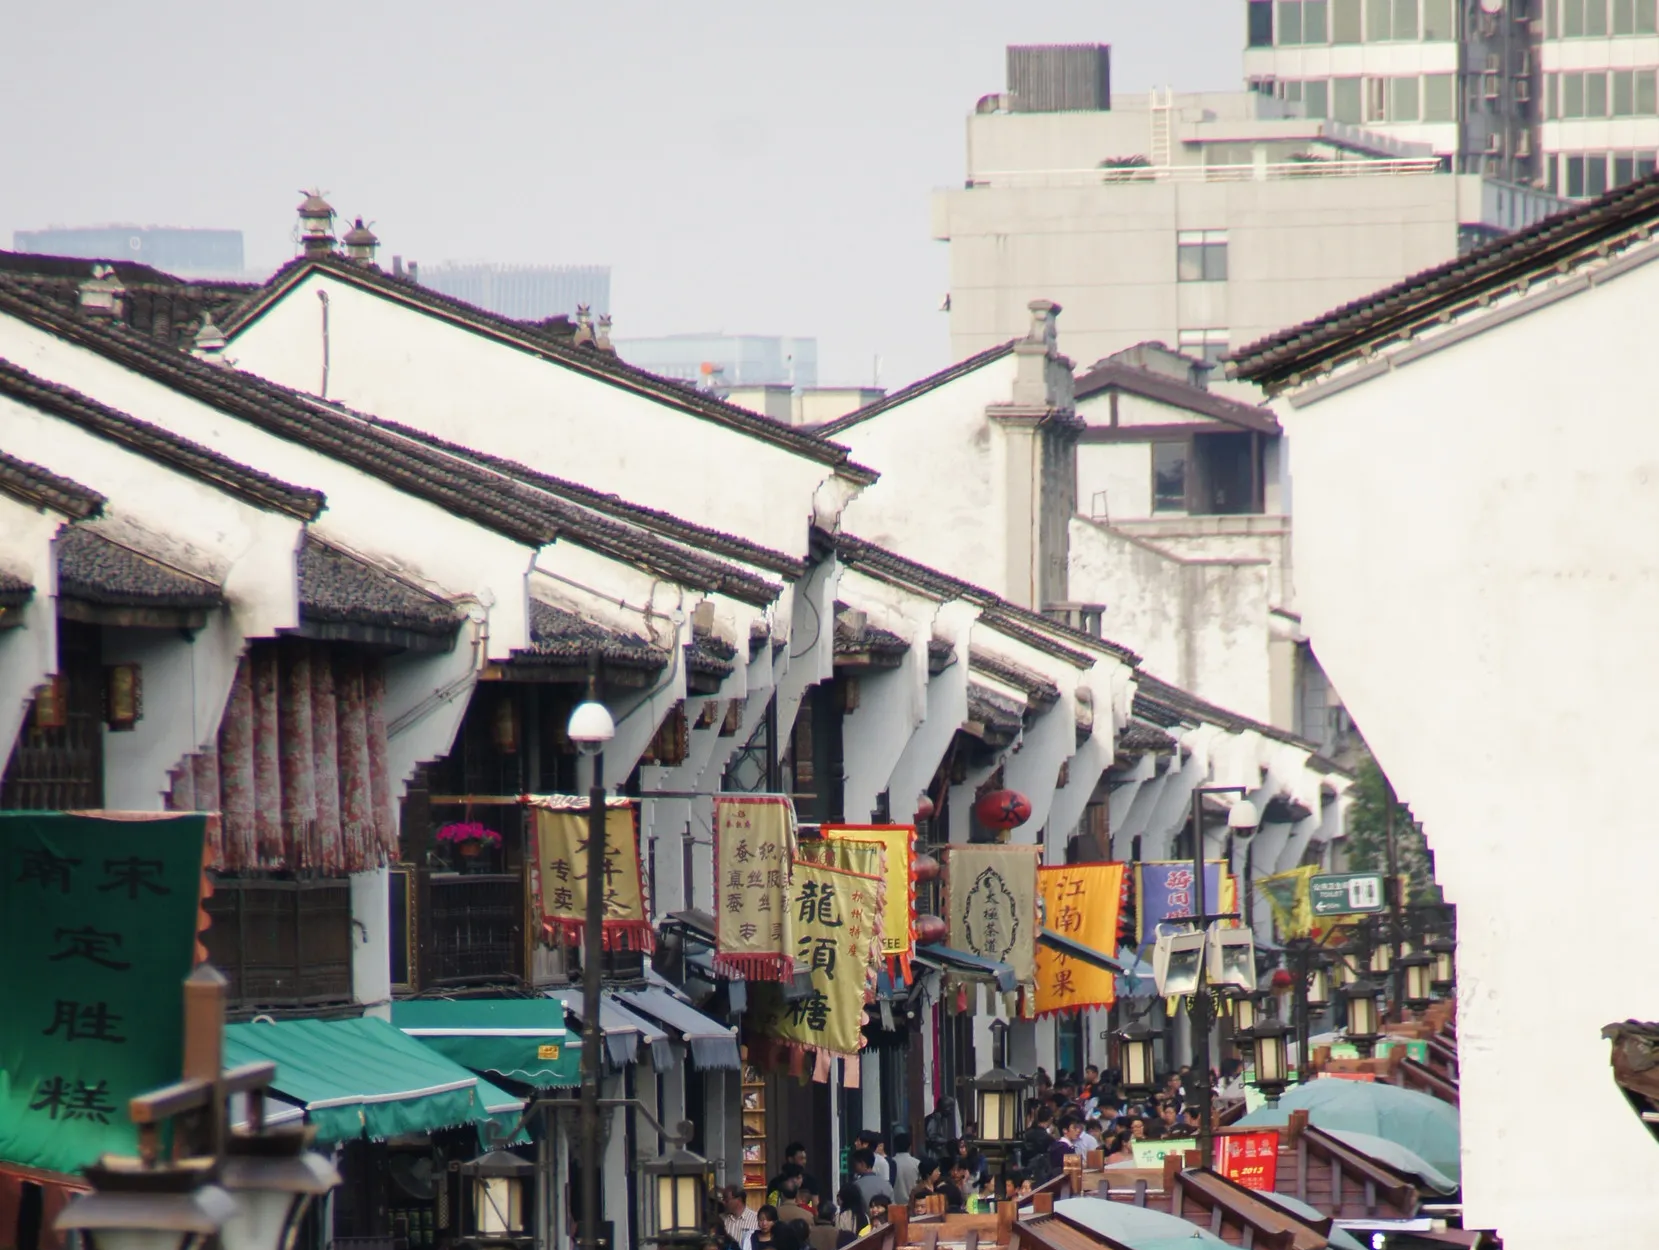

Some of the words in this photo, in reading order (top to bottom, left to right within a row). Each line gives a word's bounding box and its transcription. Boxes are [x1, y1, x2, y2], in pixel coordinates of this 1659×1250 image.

[14, 847, 171, 900] 南宋
[550, 858, 574, 911] 专卖
[784, 880, 843, 1032] 龍須糖
[29, 925, 132, 1125] 定胜糕
[1241, 1166, 1264, 1175] 2013
